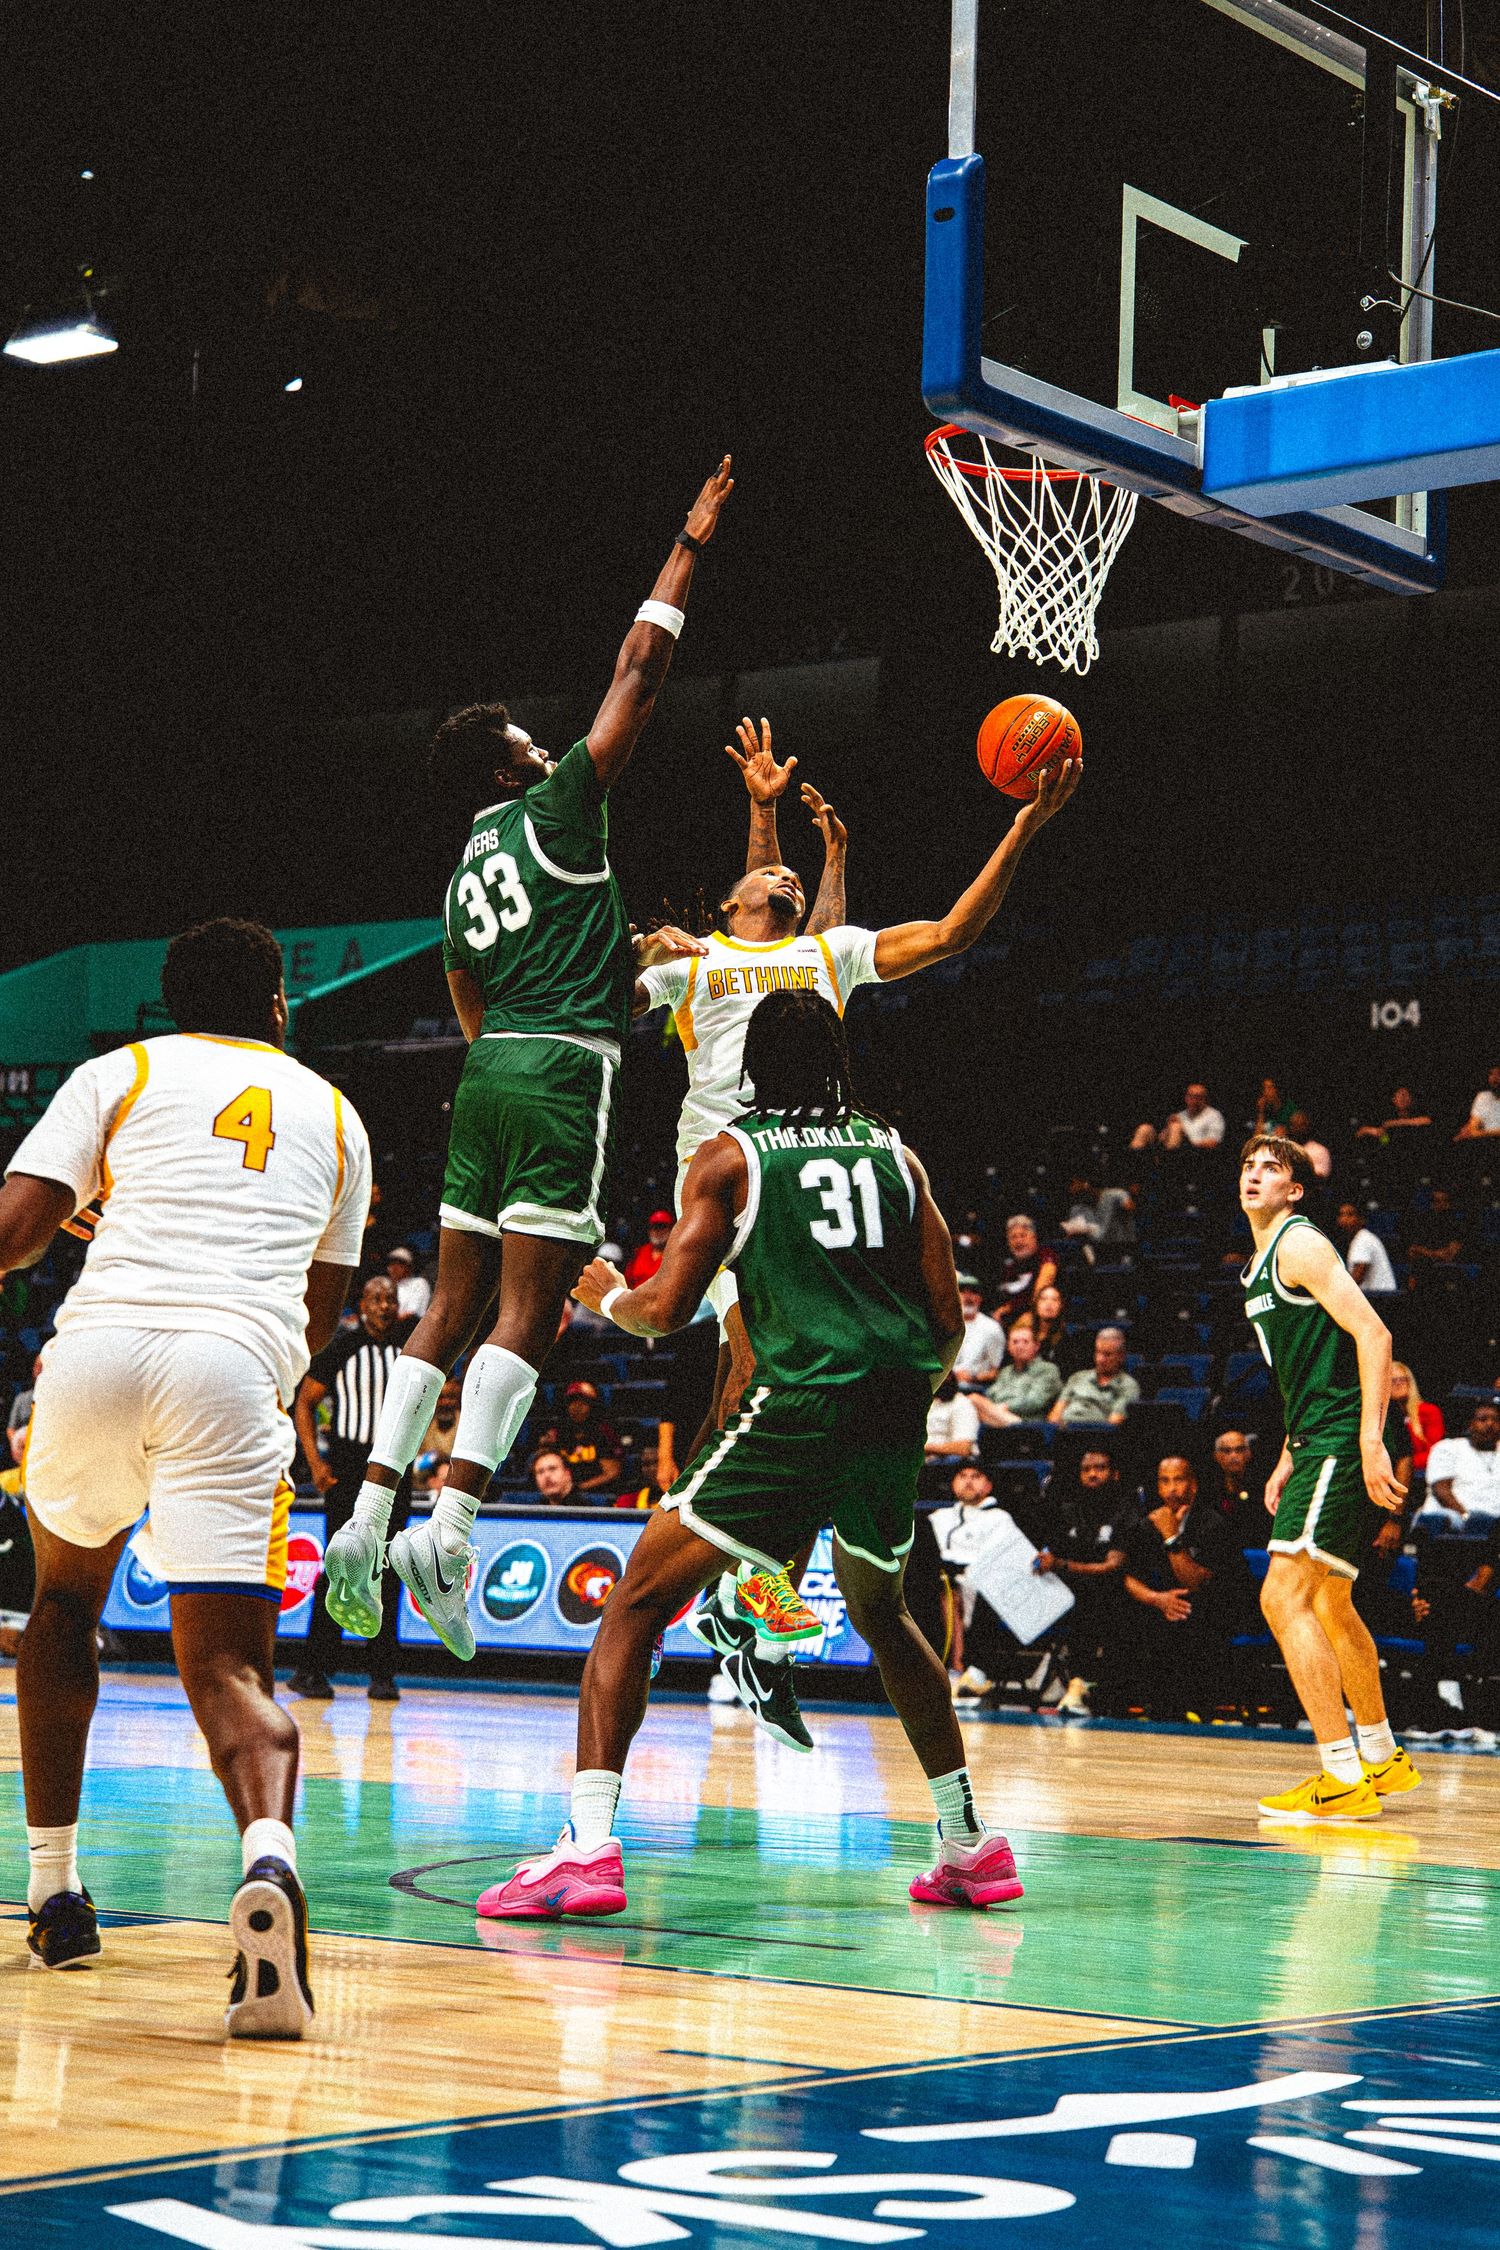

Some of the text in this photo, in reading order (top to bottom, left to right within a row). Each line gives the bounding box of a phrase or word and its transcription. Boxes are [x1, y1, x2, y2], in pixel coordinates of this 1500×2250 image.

[456, 850, 533, 952] 33
[1369, 1000, 1422, 1031] 104
[212, 1085, 277, 1173] 4
[798, 1157, 884, 1250] 31
